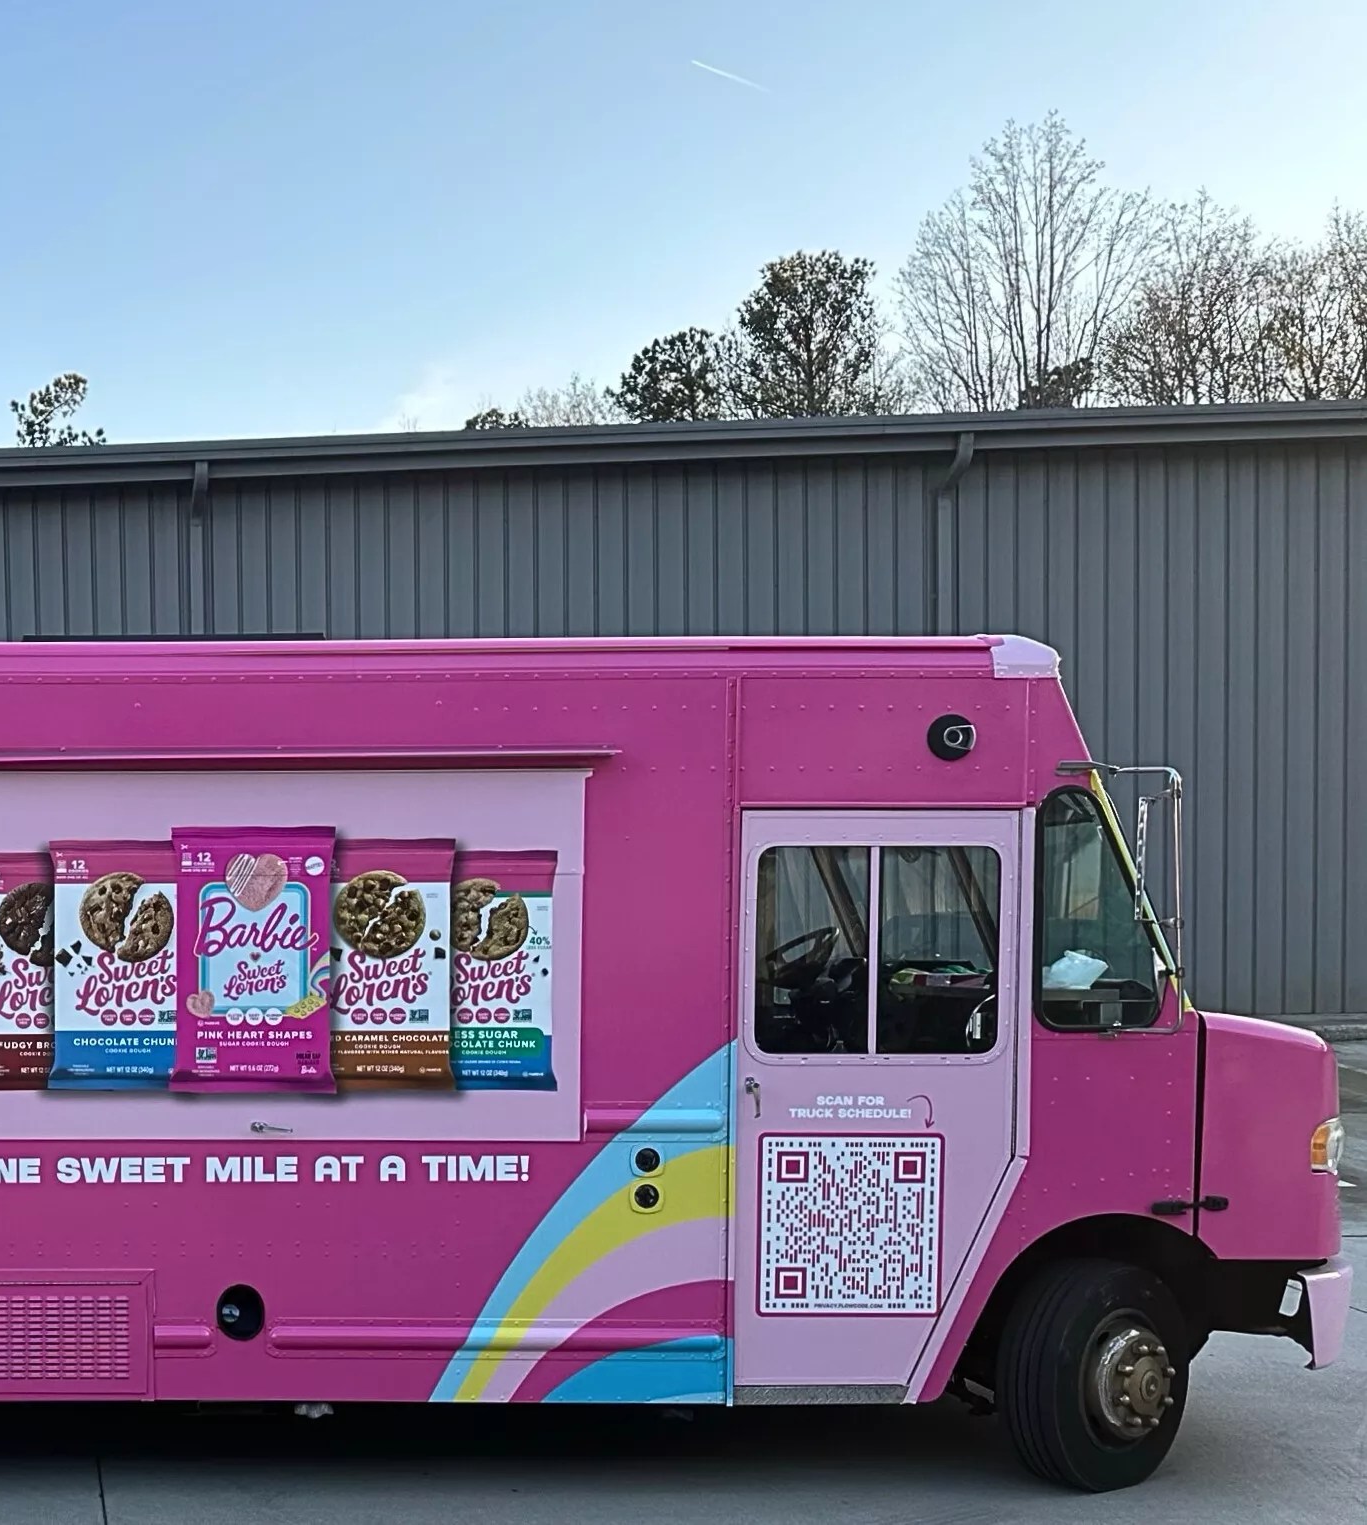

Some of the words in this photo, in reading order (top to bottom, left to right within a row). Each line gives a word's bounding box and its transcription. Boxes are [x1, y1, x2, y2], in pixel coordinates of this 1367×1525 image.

[197, 852, 211, 862] 12
[71, 860, 86, 870] 12
[195, 897, 319, 957] Barbie
[529, 936, 550, 945] 40%
[97, 949, 174, 985] Sweet
[347, 948, 426, 983] Sweet
[454, 950, 529, 984] Sweet
[237, 960, 284, 982] Sweet
[197, 1031, 224, 1039] PINK
[227, 1031, 264, 1039] HEART
[268, 1031, 313, 1039] SHAPES
[344, 1034, 389, 1042] CARAMEL
[392, 1034, 449, 1042] CHOCOLATE
[478, 1030, 518, 1039] SUGAR
[73, 1038, 139, 1046] CHOCOLATE
[142, 1038, 177, 1046] CHUN
[498, 1040, 536, 1048] CHUNK
[816, 1095, 853, 1106] SCAN
[857, 1095, 885, 1106] FOR
[789, 1108, 834, 1119] TRUCK
[837, 1108, 912, 1119] SCHEDULE!
[56, 1157, 191, 1184] SWEET
[205, 1156, 299, 1183] MILE
[314, 1156, 364, 1183] AT
[379, 1156, 407, 1182] A
[421, 1155, 531, 1182] TIME!
